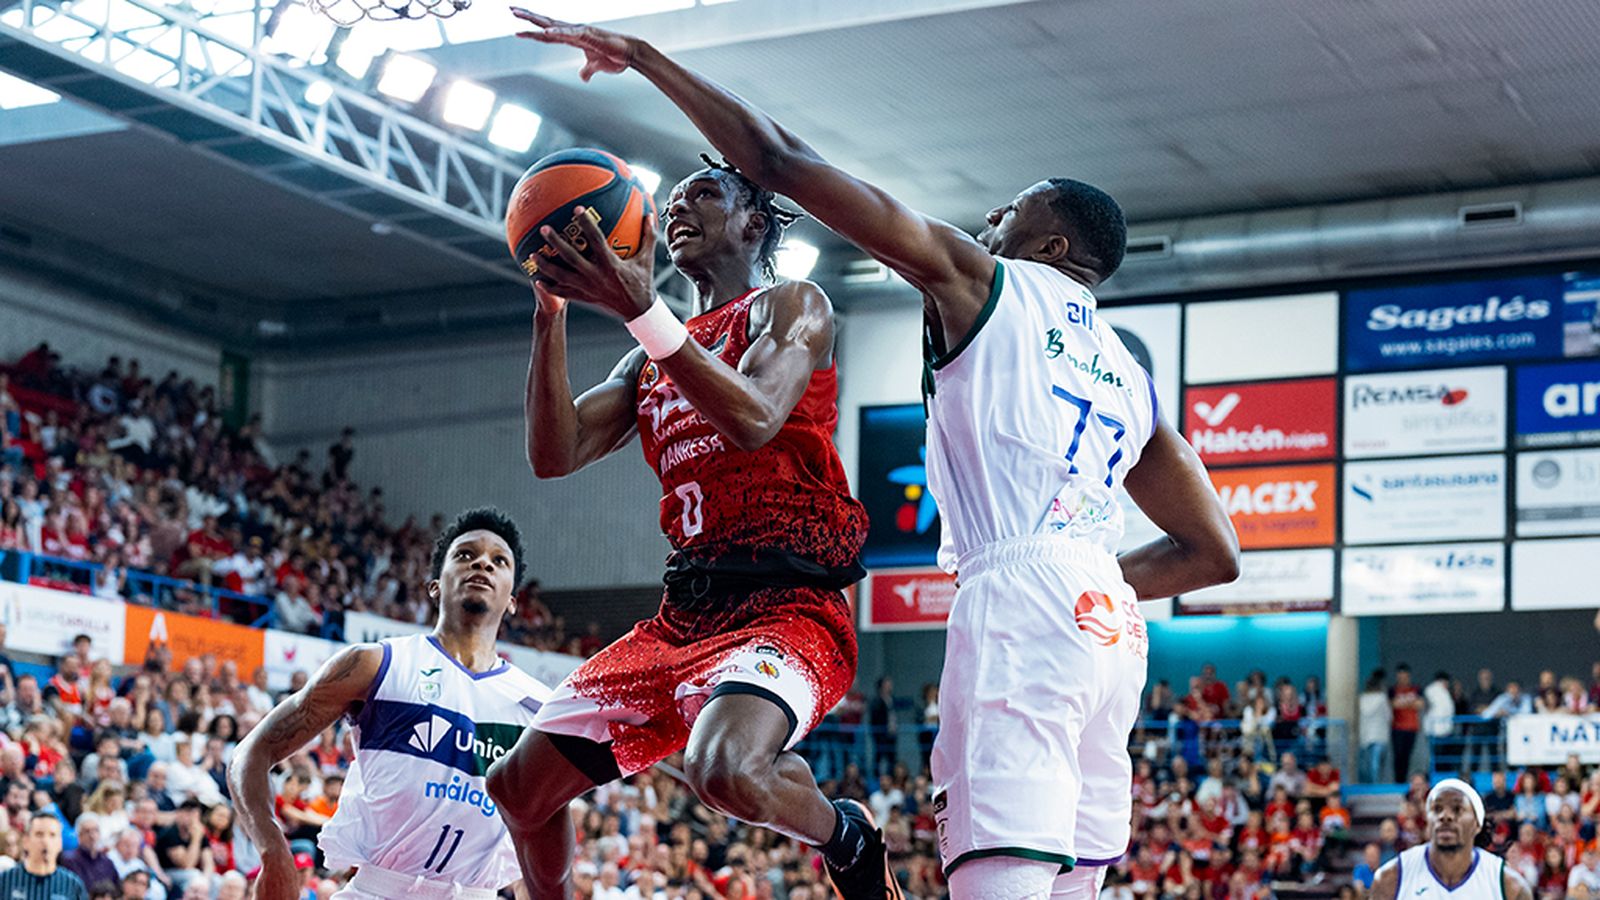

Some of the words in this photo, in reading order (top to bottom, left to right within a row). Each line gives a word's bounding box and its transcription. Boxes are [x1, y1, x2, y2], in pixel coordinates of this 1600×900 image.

[1367, 296, 1551, 331] Sagalés
[1379, 332, 1536, 357] www.sagales.com
[1052, 384, 1126, 488] 77
[675, 481, 703, 537] 0
[456, 729, 510, 760] Unic
[425, 776, 494, 817] málag
[424, 824, 464, 874] 11
